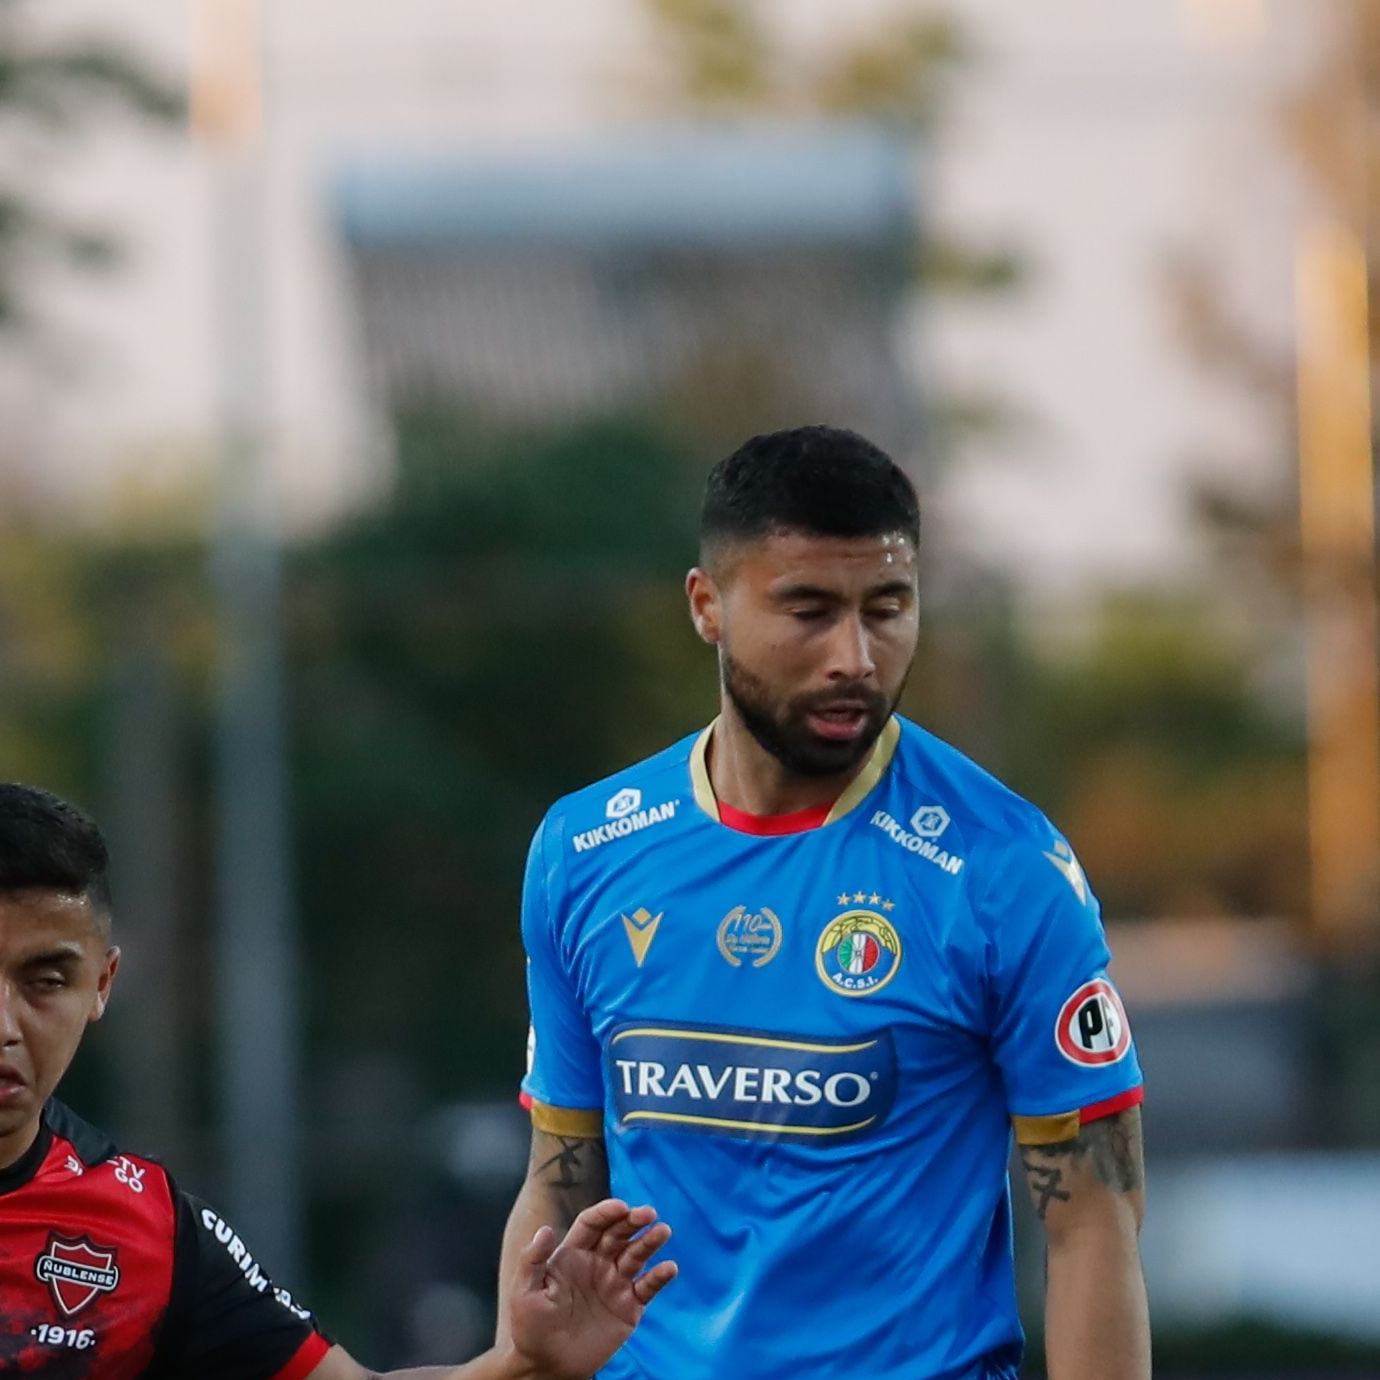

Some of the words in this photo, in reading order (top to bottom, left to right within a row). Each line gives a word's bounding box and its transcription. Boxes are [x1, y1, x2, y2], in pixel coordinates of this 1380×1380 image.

[572, 800, 676, 853] KIKKOMAN
[870, 809, 965, 875] KIKKOMAN
[616, 1060, 871, 1107] TRAVERSO
[114, 1166, 144, 1193] GO
[42, 1259, 115, 1287] ÑUBLENSE
